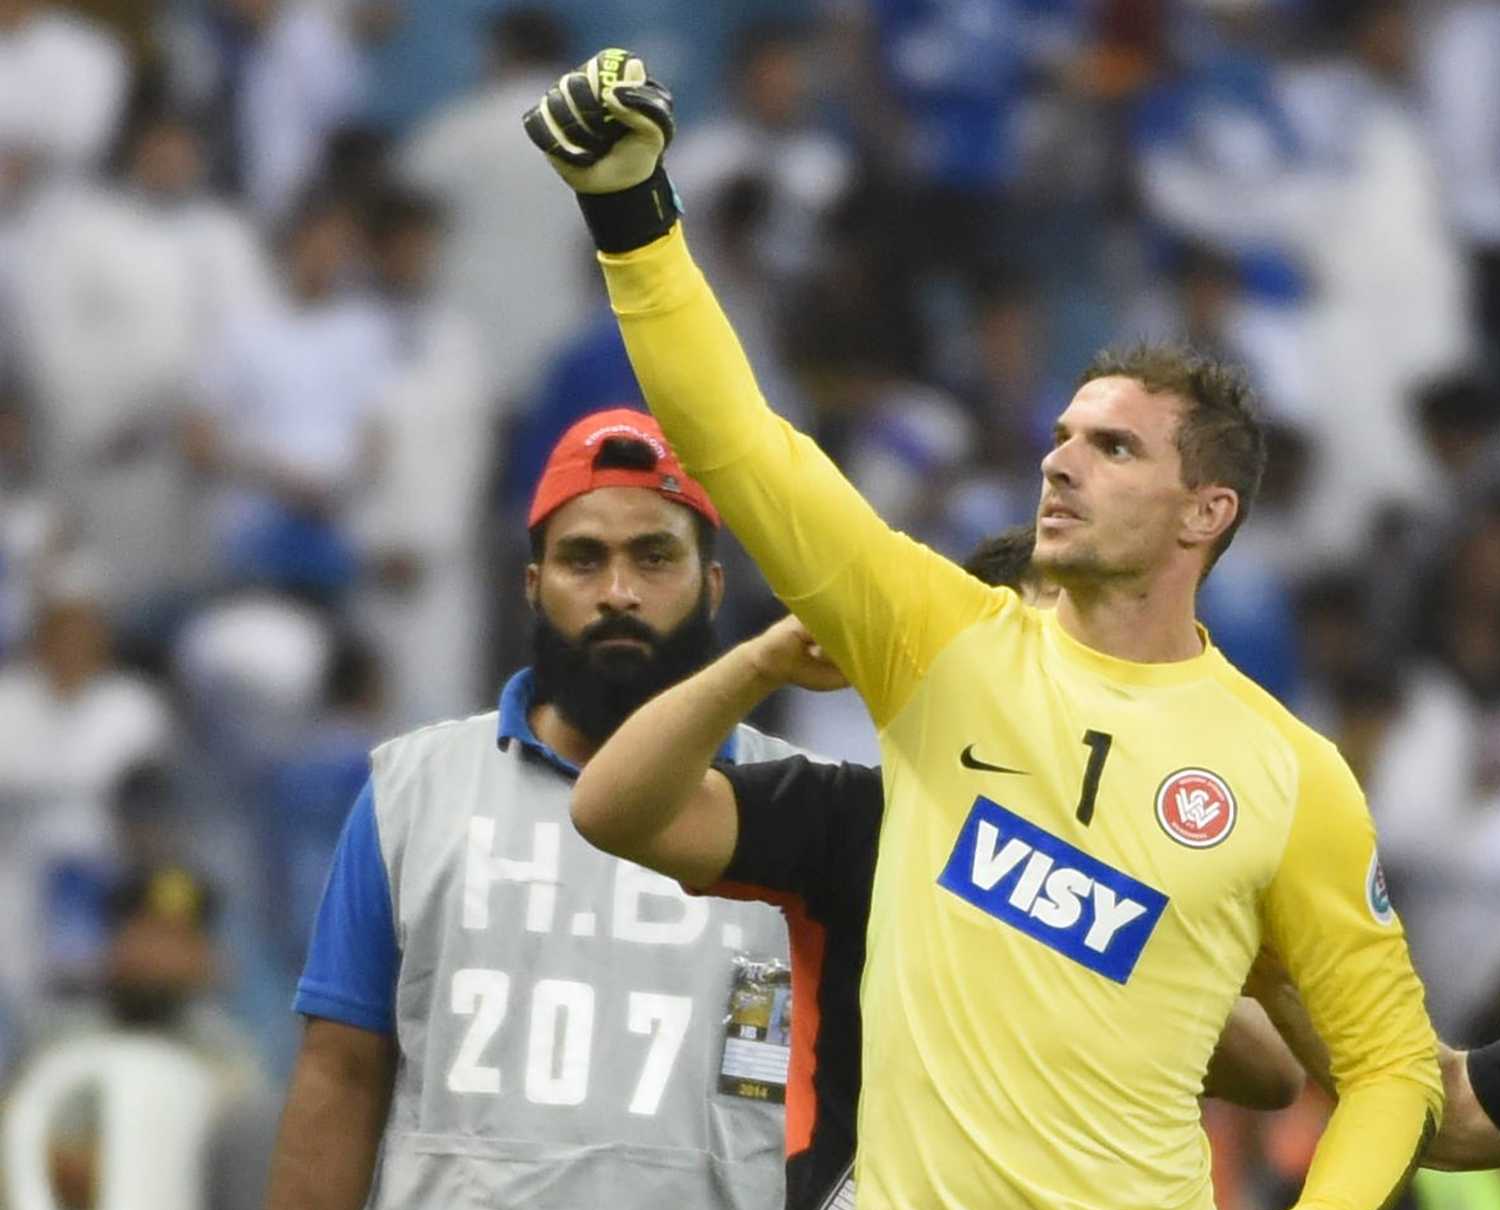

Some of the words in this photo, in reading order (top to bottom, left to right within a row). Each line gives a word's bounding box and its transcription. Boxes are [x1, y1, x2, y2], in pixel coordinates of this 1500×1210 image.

[1076, 729, 1113, 828] 1
[970, 819, 1148, 953] VISY
[447, 968, 693, 1115] 207
